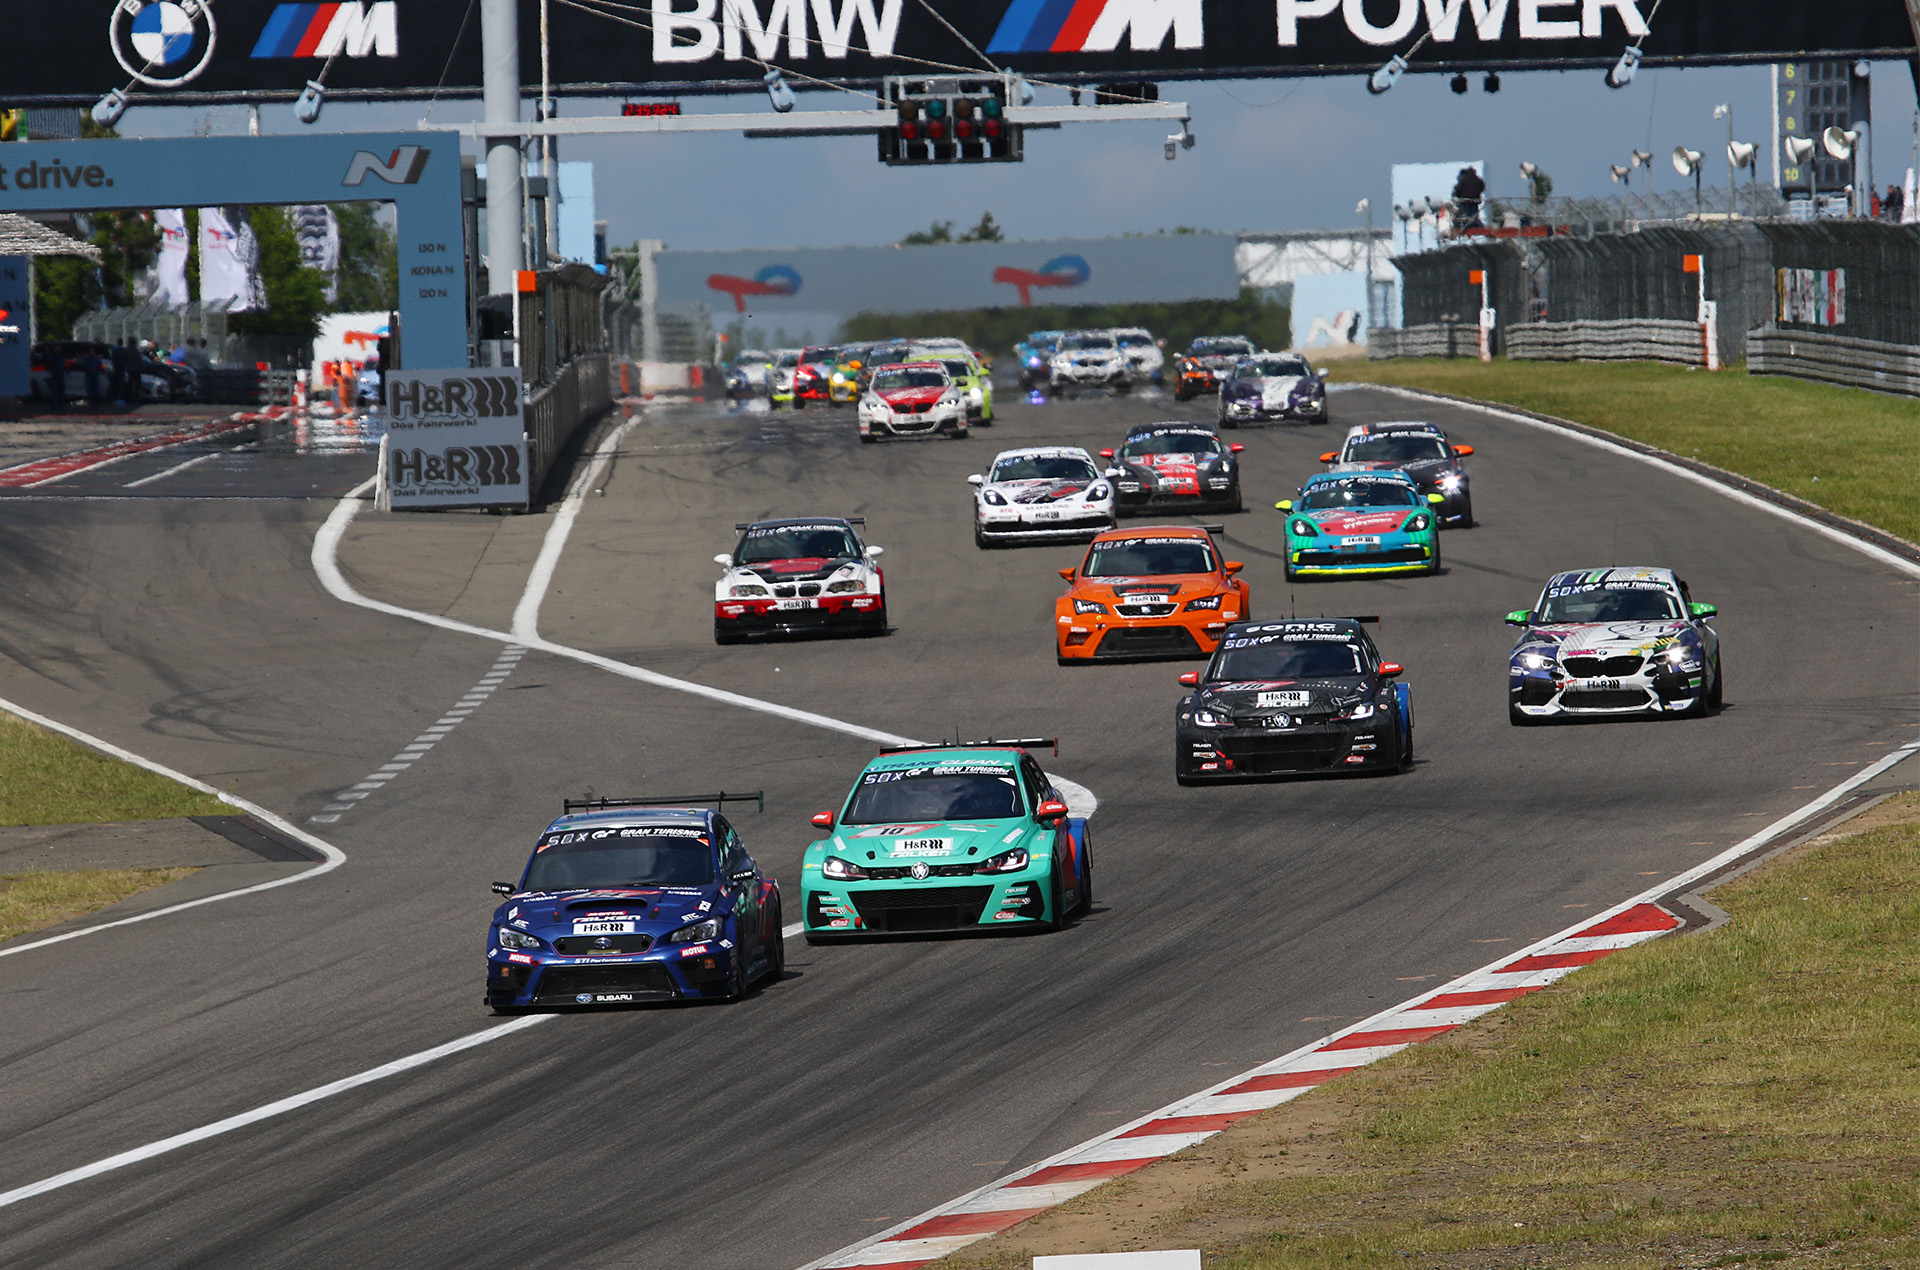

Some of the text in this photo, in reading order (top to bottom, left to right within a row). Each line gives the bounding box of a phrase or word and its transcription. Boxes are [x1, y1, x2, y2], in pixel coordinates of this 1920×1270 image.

[652, 0, 903, 63] BMW
[1277, 0, 1651, 46] POWER
[1785, 62, 1796, 79] 6
[1785, 90, 1796, 106] 7
[1785, 116, 1796, 131] 8
[15, 158, 114, 189] drive.
[1784, 167, 1798, 182] 10
[437, 243, 446, 252] N
[411, 265, 455, 275] KONA N
[438, 288, 447, 298] N
[391, 378, 475, 420] H&R
[391, 421, 414, 429] Das
[392, 447, 478, 488] H&R
[393, 488, 416, 497] Das
[932, 766, 963, 775] GRAN
[620, 828, 651, 836] GRAN
[652, 828, 702, 837] TURISMO
[879, 827, 905, 835] 10
[889, 850, 951, 858] FALKEN
[571, 914, 642, 924] FALKEN
[682, 945, 707, 957] MOTUL
[509, 953, 532, 963] MOTUL
[596, 994, 633, 1002] SUBARU
